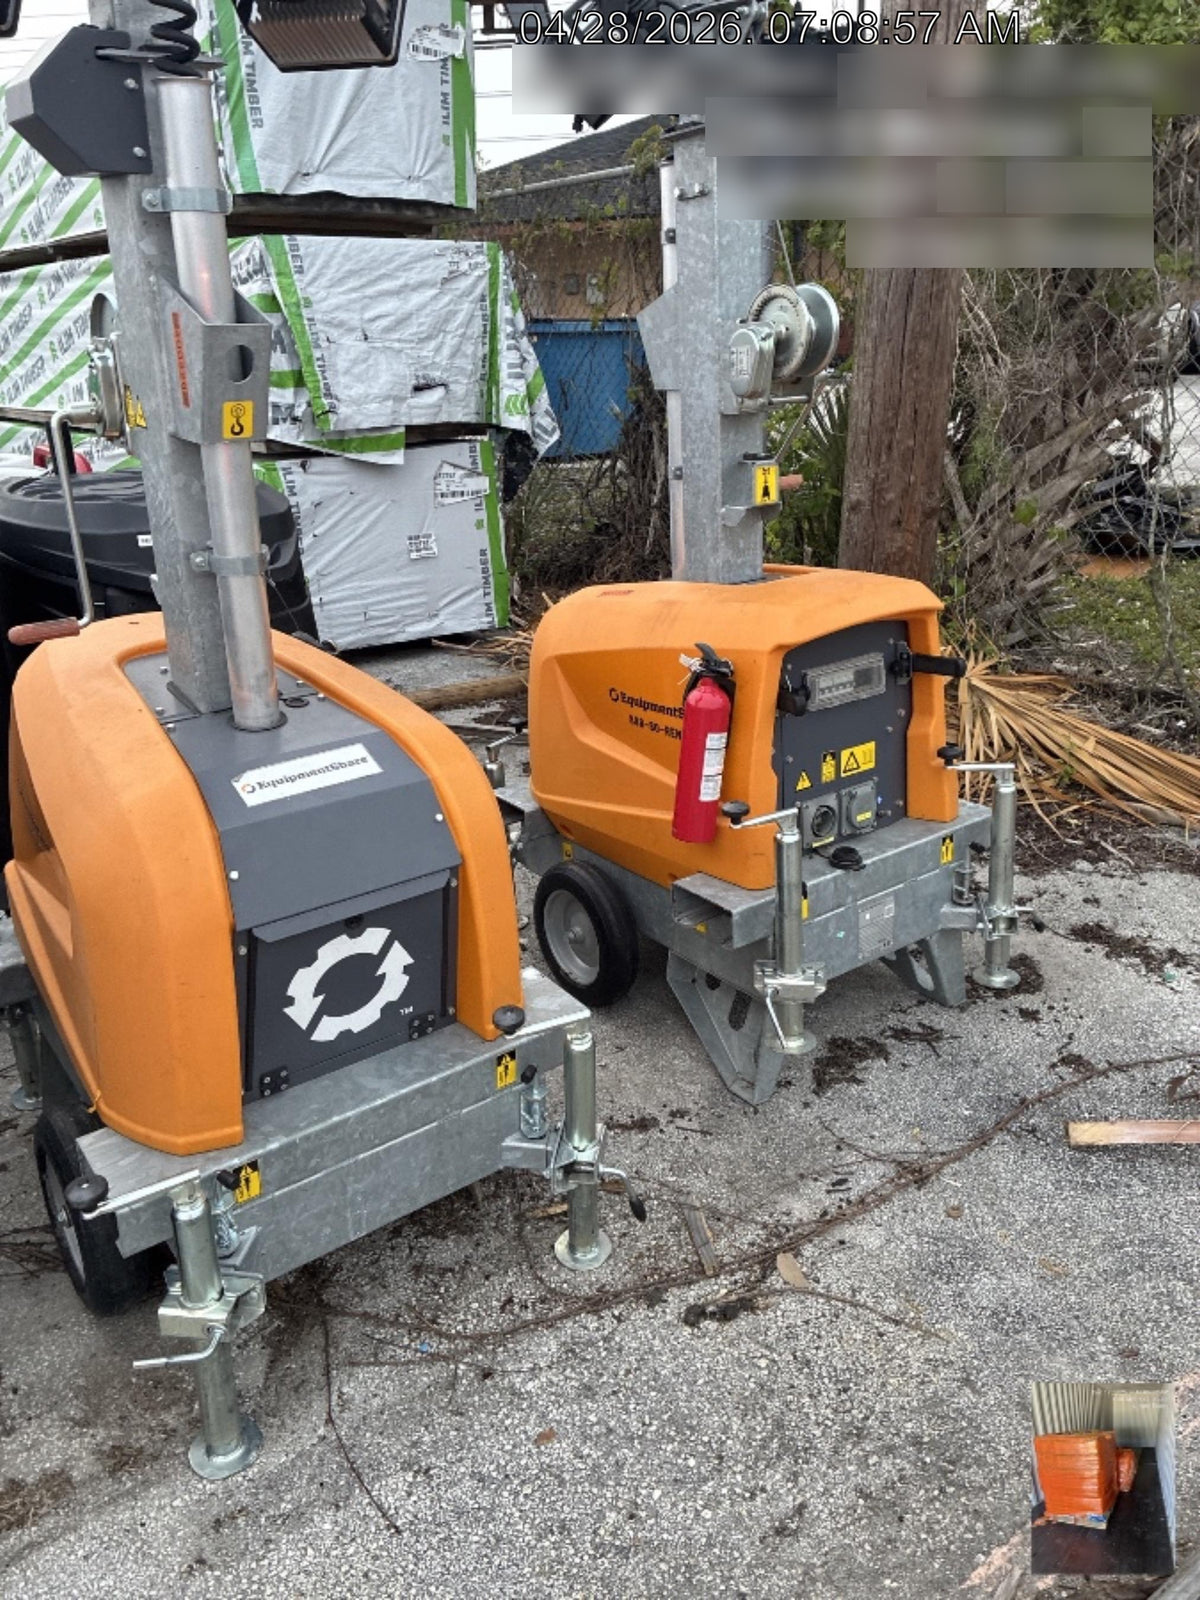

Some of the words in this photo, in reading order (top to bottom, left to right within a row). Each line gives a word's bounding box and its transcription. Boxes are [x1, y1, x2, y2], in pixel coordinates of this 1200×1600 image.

[244, 61, 264, 129] TIMBER
[440, 92, 450, 126] ILIM
[281, 466, 298, 497] ILIM
[479, 548, 492, 597] TIMBER
[620, 691, 685, 719] EquipmentS
[256, 756, 368, 790] EquipmentShare
